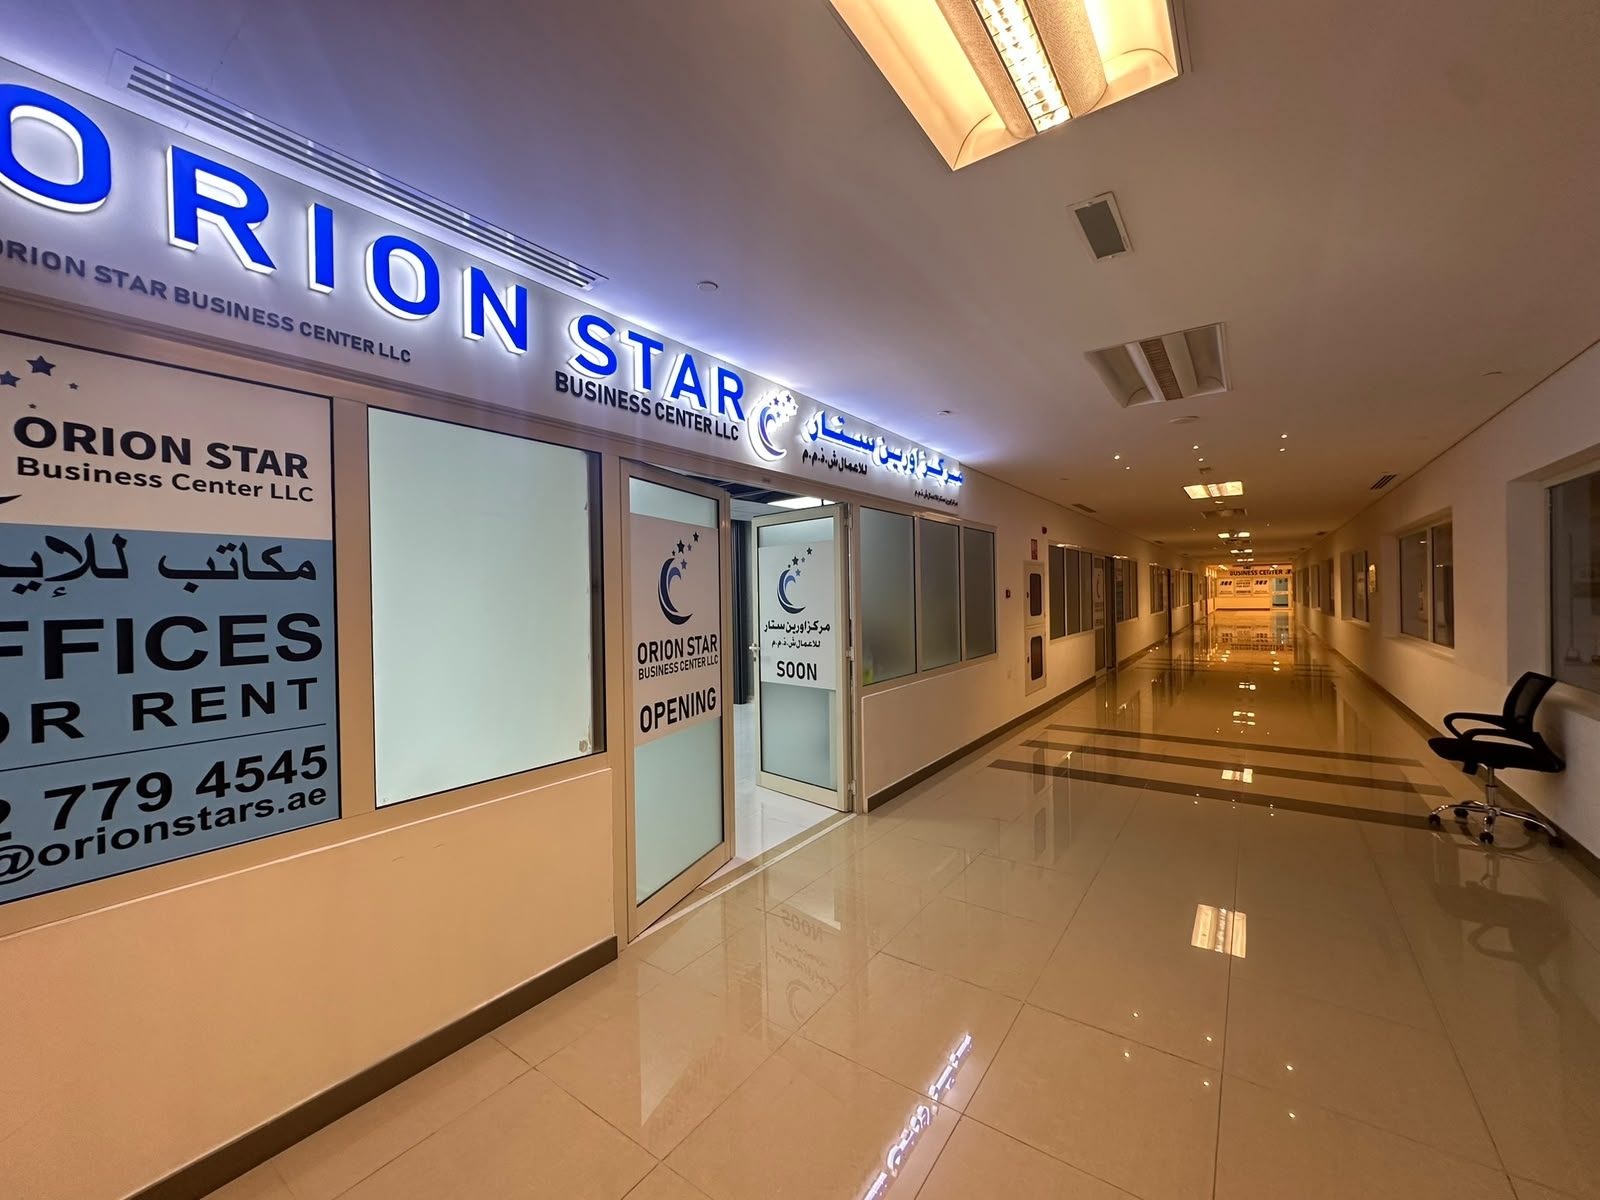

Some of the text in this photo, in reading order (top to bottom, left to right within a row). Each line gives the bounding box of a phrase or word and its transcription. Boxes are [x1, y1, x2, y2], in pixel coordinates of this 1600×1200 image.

[0, 84, 746, 423] ORION STAR
[0, 239, 411, 363] RION STAR BUSINESS CENTER LLC
[555, 370, 739, 441] BUSINESS CENTER LLC
[14, 416, 309, 479] ORION STAR
[17, 456, 313, 502] Business Center LLC
[158, 542, 316, 594] مكاتب
[1259, 568, 1283, 576] CENTER
[637, 633, 718, 664] ORION STAR
[638, 654, 719, 680] BUSINESS CENTER LLC
[776, 660, 817, 681] SOON
[132, 677, 318, 731] RENT
[640, 687, 716, 733] OPENING
[44, 771, 173, 831] 779
[195, 744, 327, 799] 4545
